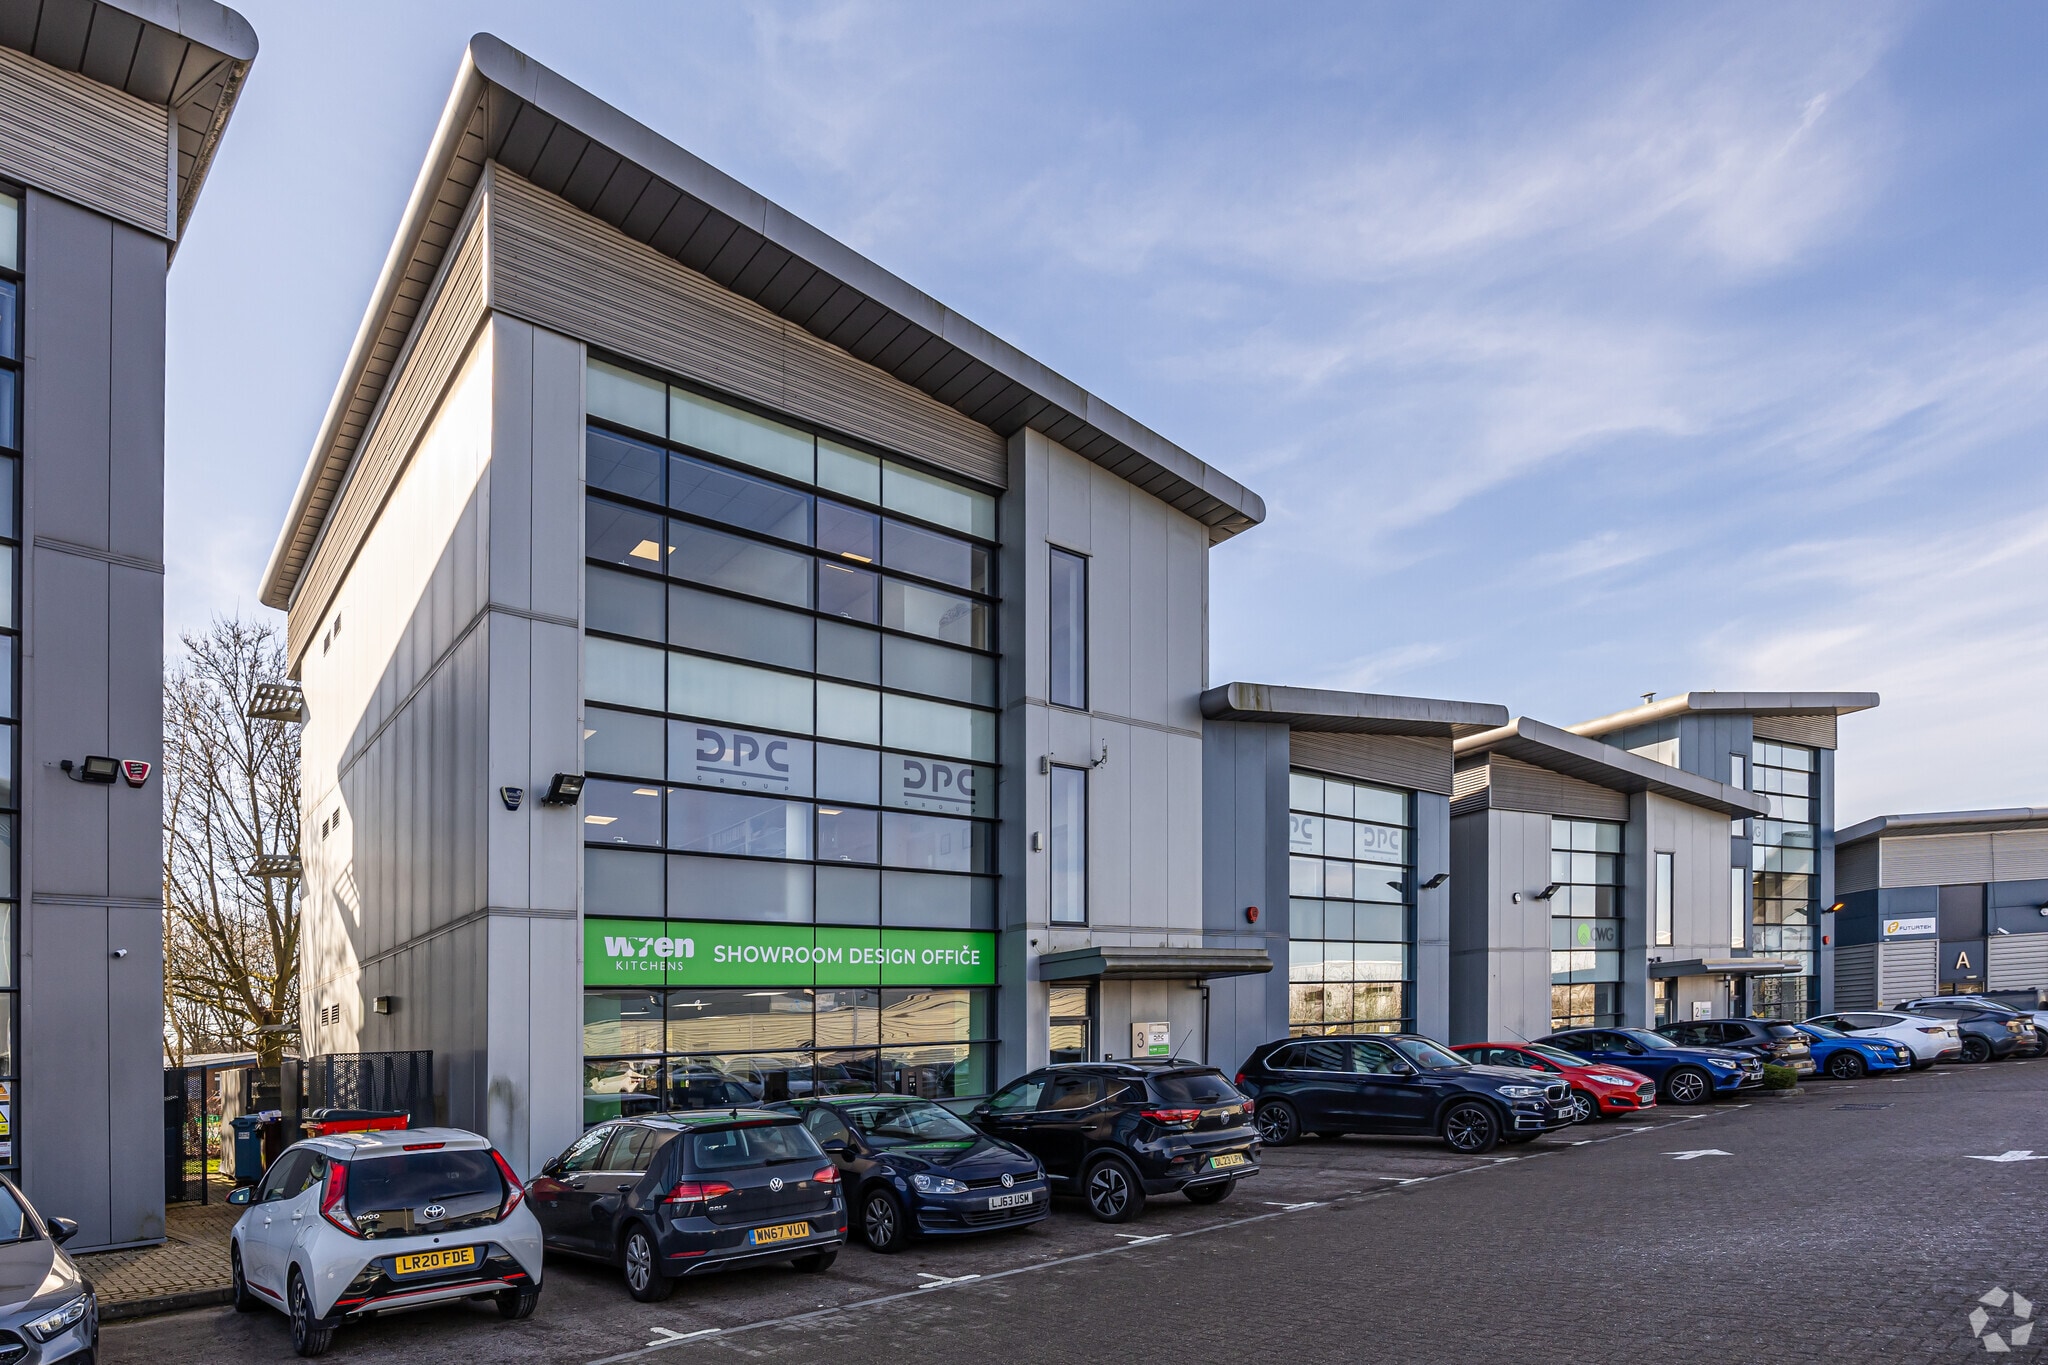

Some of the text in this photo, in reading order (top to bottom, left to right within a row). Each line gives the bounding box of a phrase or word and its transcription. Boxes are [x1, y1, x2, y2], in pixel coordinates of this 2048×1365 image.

[696, 728, 789, 773] DPC
[697, 775, 789, 791] GROUP
[903, 760, 976, 797] DPC
[904, 800, 976, 813] GROUP
[1364, 826, 1399, 850] DPC
[1590, 927, 1614, 942] CWG
[604, 936, 695, 958] wren
[713, 945, 842, 964] SHOWROOM
[849, 947, 916, 965] DESIGN
[616, 961, 683, 971] KITCHENS
[1955, 951, 1971, 970] A
[1136, 1031, 1145, 1048] 3
[991, 1196, 1012, 1208] LJ63
[756, 1227, 784, 1241] WN67
[787, 1223, 807, 1236] VUV
[402, 1249, 470, 1271] LR20 FDE
